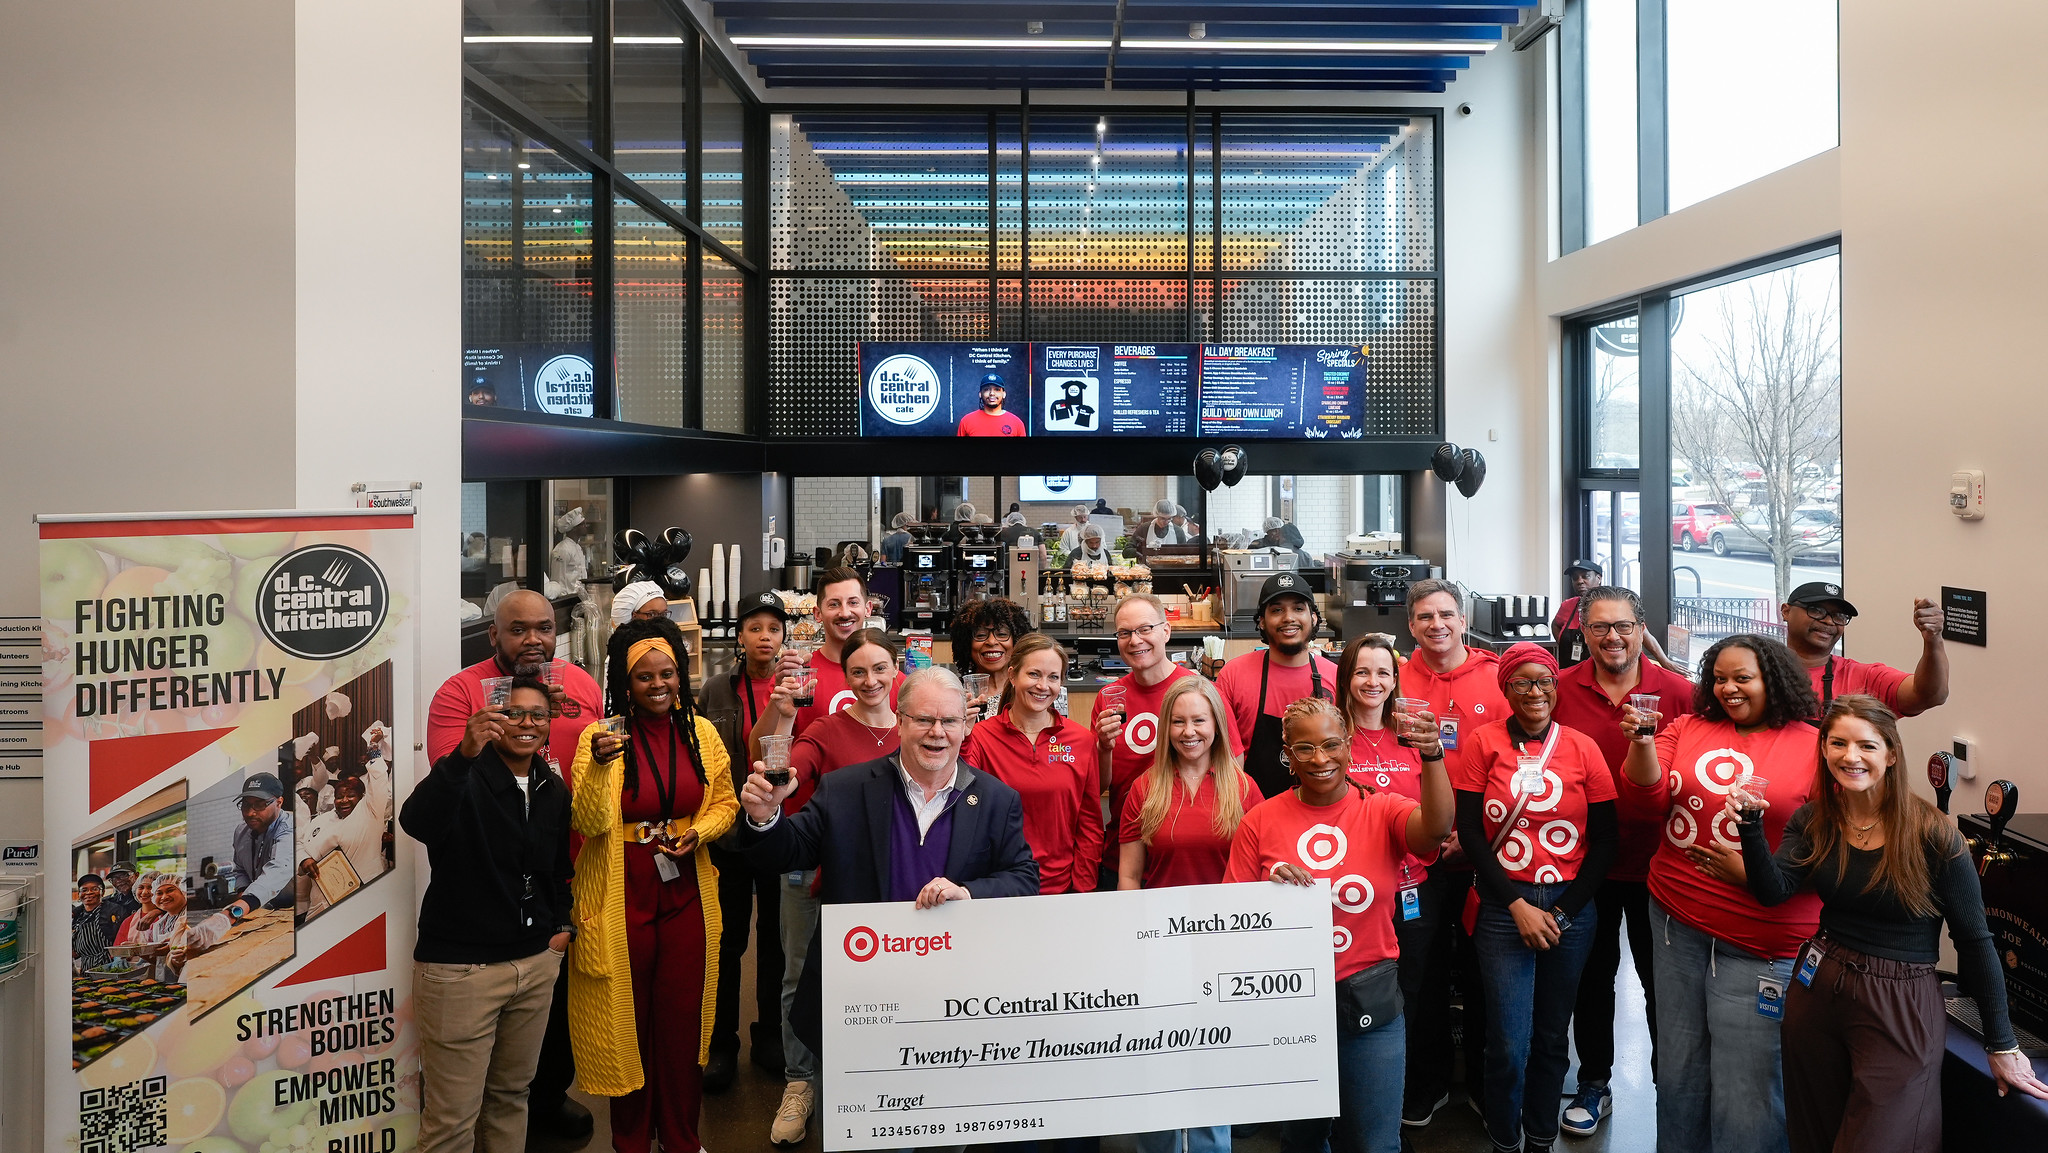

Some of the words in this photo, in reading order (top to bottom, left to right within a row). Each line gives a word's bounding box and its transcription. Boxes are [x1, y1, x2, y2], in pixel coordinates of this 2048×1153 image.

[1049, 351, 1067, 359] EVERY
[1068, 351, 1097, 359] PURCHASE
[1114, 346, 1156, 356] BEVERAGES
[1204, 346, 1218, 356] ALL
[1219, 347, 1233, 357] DAY
[1234, 347, 1275, 357] BREAKFAST
[1317, 349, 1350, 364] Spring
[880, 371, 904, 381] d.c.
[880, 381, 929, 392] central
[880, 393, 930, 404] kitchen
[1202, 408, 1222, 418] BUILD
[1223, 408, 1242, 418] YOUR
[1243, 408, 1259, 418] OWN
[1260, 408, 1283, 418] LUNCH
[373, 498, 411, 508] southwester
[274, 572, 322, 593] d.c.
[274, 585, 372, 610] central
[76, 593, 224, 634] FIGHTING
[274, 609, 372, 632] kitchen
[76, 634, 209, 676] HUNGER
[76, 668, 286, 717] DIFFERENTLY
[1048, 743, 1071, 753] take
[1048, 753, 1075, 764] pride
[7, 848, 35, 858] Purell
[1168, 914, 1226, 934] March
[1230, 912, 1272, 930] 2026
[882, 931, 952, 956] target
[1137, 930, 1160, 940] DATE
[2002, 930, 2022, 947] JOE
[1203, 981, 1212, 996] $
[1230, 973, 1302, 998] 25,000
[844, 1005, 862, 1013] PAY
[864, 1004, 878, 1012] TO
[880, 1003, 900, 1011] THE
[944, 998, 979, 1018] DC
[984, 992, 1058, 1016] Central
[1063, 989, 1140, 1011] Kitchen
[1759, 1003, 1779, 1013] VISITOR
[236, 988, 394, 1042] STRENGTHEN
[844, 1017, 879, 1025] ORDER
[880, 1016, 894, 1024] OF
[311, 1017, 394, 1057] BODIES
[1273, 1035, 1317, 1046] DOLLARS
[899, 1043, 1021, 1069] Twenty-Five
[1026, 1034, 1122, 1059] Thousand
[1126, 1030, 1163, 1052] and
[1167, 1026, 1232, 1048] 00/100
[275, 1058, 395, 1106] EMPOWER
[320, 1086, 395, 1126] MINDS
[837, 1105, 866, 1113] FROM
[877, 1093, 924, 1111] Target
[846, 1128, 853, 1138] 1
[872, 1124, 946, 1137] 123456789
[955, 1118, 1045, 1133] 19876979841
[329, 1128, 395, 1153] BUILD
